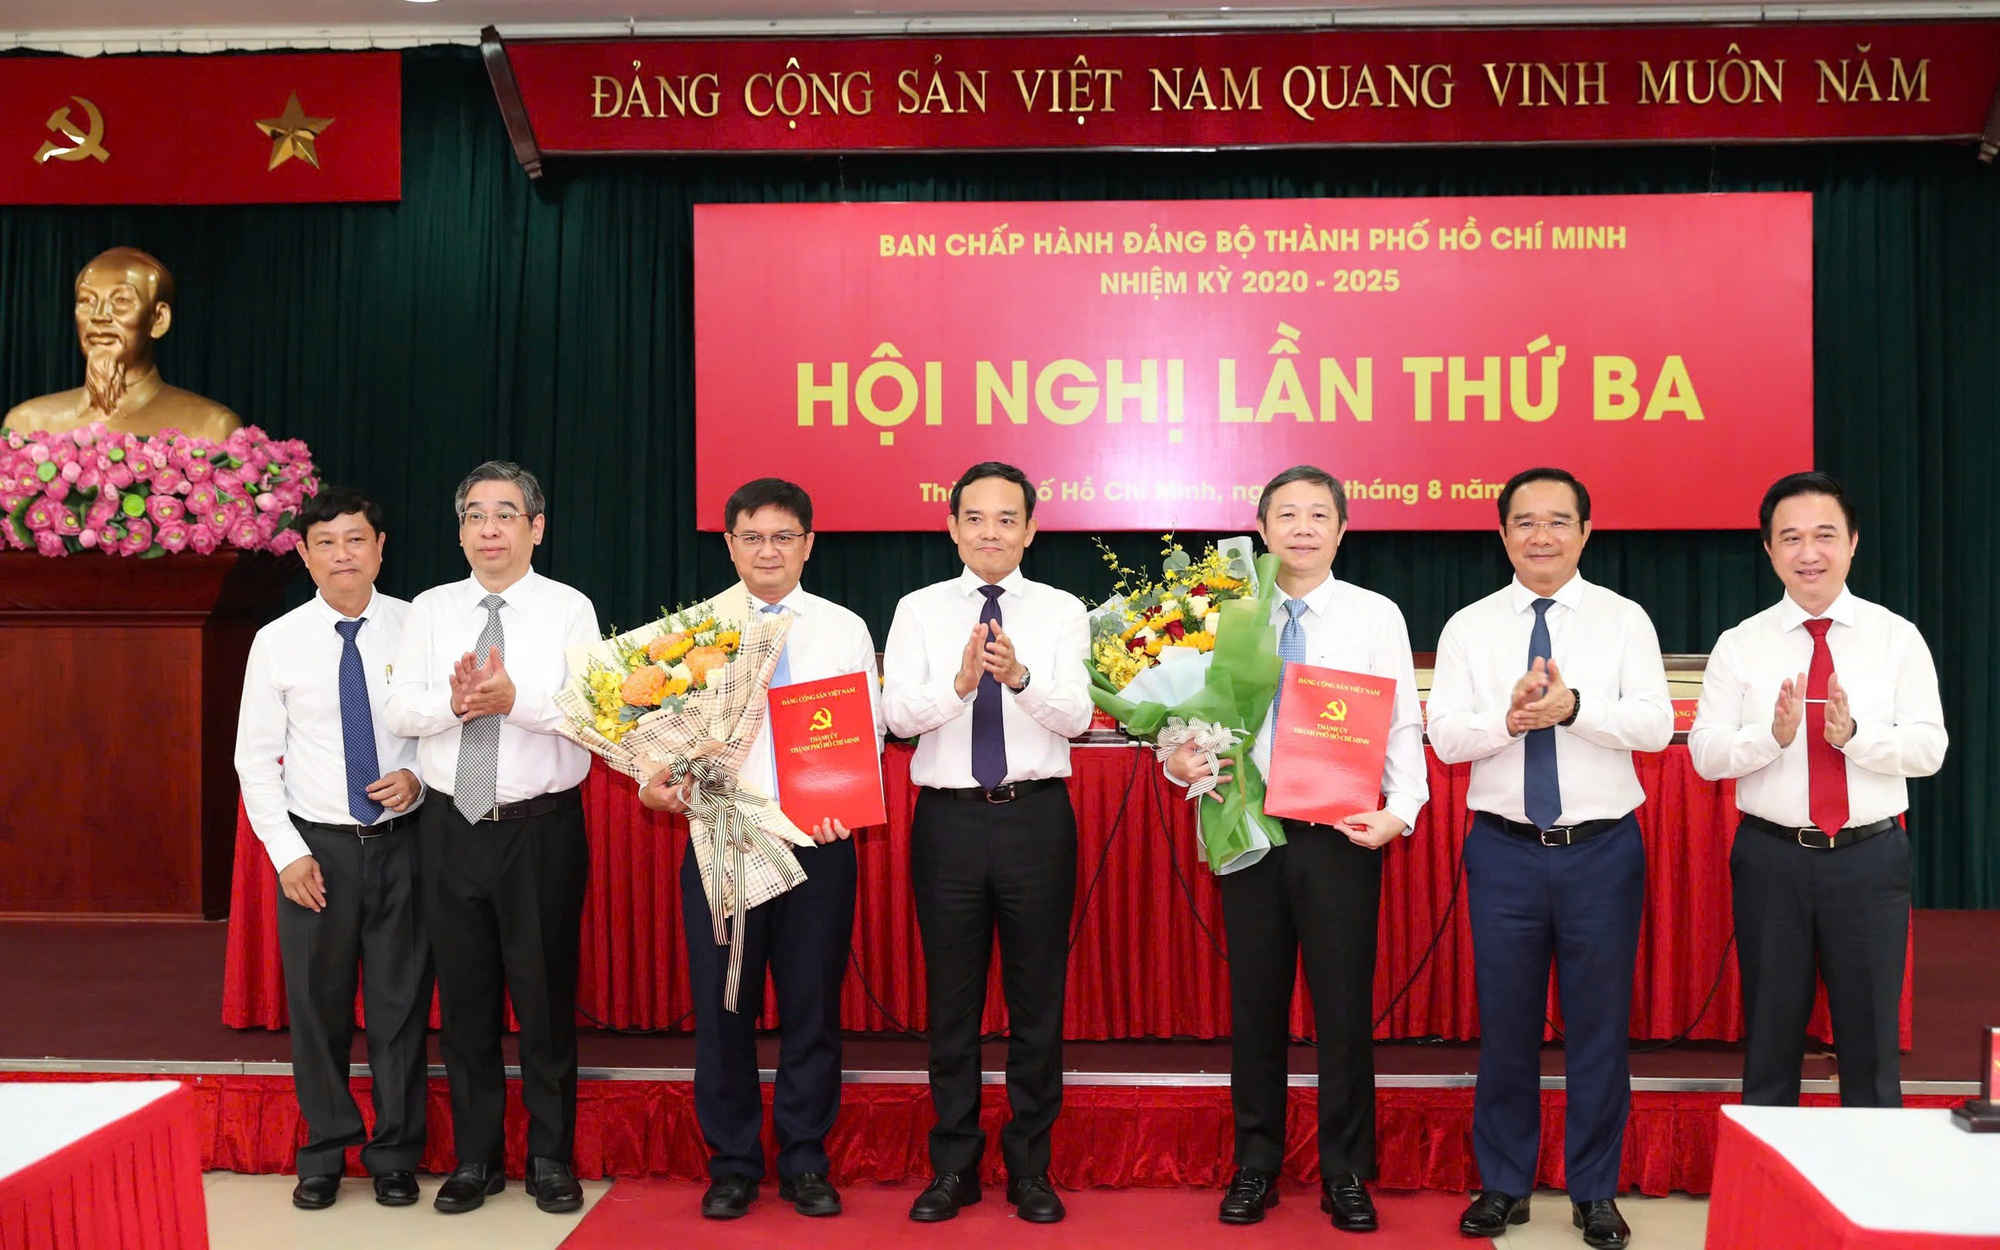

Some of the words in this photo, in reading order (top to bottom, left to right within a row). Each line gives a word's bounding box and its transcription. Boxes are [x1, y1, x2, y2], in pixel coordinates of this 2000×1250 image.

[591, 60, 721, 118] ĐẢNG
[744, 57, 873, 129] CỘNG
[898, 54, 988, 114] SẢN
[1013, 55, 1122, 125] VIỆT
[1149, 67, 1263, 111] NAM
[1283, 65, 1454, 120] QUANG
[1483, 62, 1609, 106] VINH
[1638, 42, 1784, 104] MUÔN
[1816, 43, 1931, 103] NĂM
[880, 234, 936, 257] BAN
[945, 225, 1024, 256] CHẤP
[1034, 226, 1113, 254] HÀNH
[1123, 224, 1206, 254] ĐẢNG
[1217, 225, 1256, 258] BỘ
[1265, 224, 1359, 252] THÀNH
[1370, 217, 1430, 251] PHỐ
[1439, 216, 1482, 250] HỒ
[1491, 220, 1543, 250] CHÍ
[1552, 226, 1627, 250] MINH
[1101, 267, 1187, 299] NHIỆM
[1198, 266, 1232, 293] KỲ
[1242, 270, 1308, 293] 2020
[1333, 270, 1400, 292] 2025
[797, 342, 943, 446] HỘI
[976, 358, 1184, 443] NGHỊ
[1220, 321, 1374, 423] LẦN
[1402, 334, 1567, 422] THỨ
[1593, 355, 1706, 421] BA
[1062, 475, 1096, 501] Hồ
[1343, 478, 1419, 505] tháng
[1426, 479, 1443, 500] 8
[1450, 478, 1506, 500] năm
[841, 686, 856, 694] NAM
[1365, 688, 1381, 696] NAM
[844, 736, 860, 745] MINH
[1352, 737, 1370, 745] MINH
